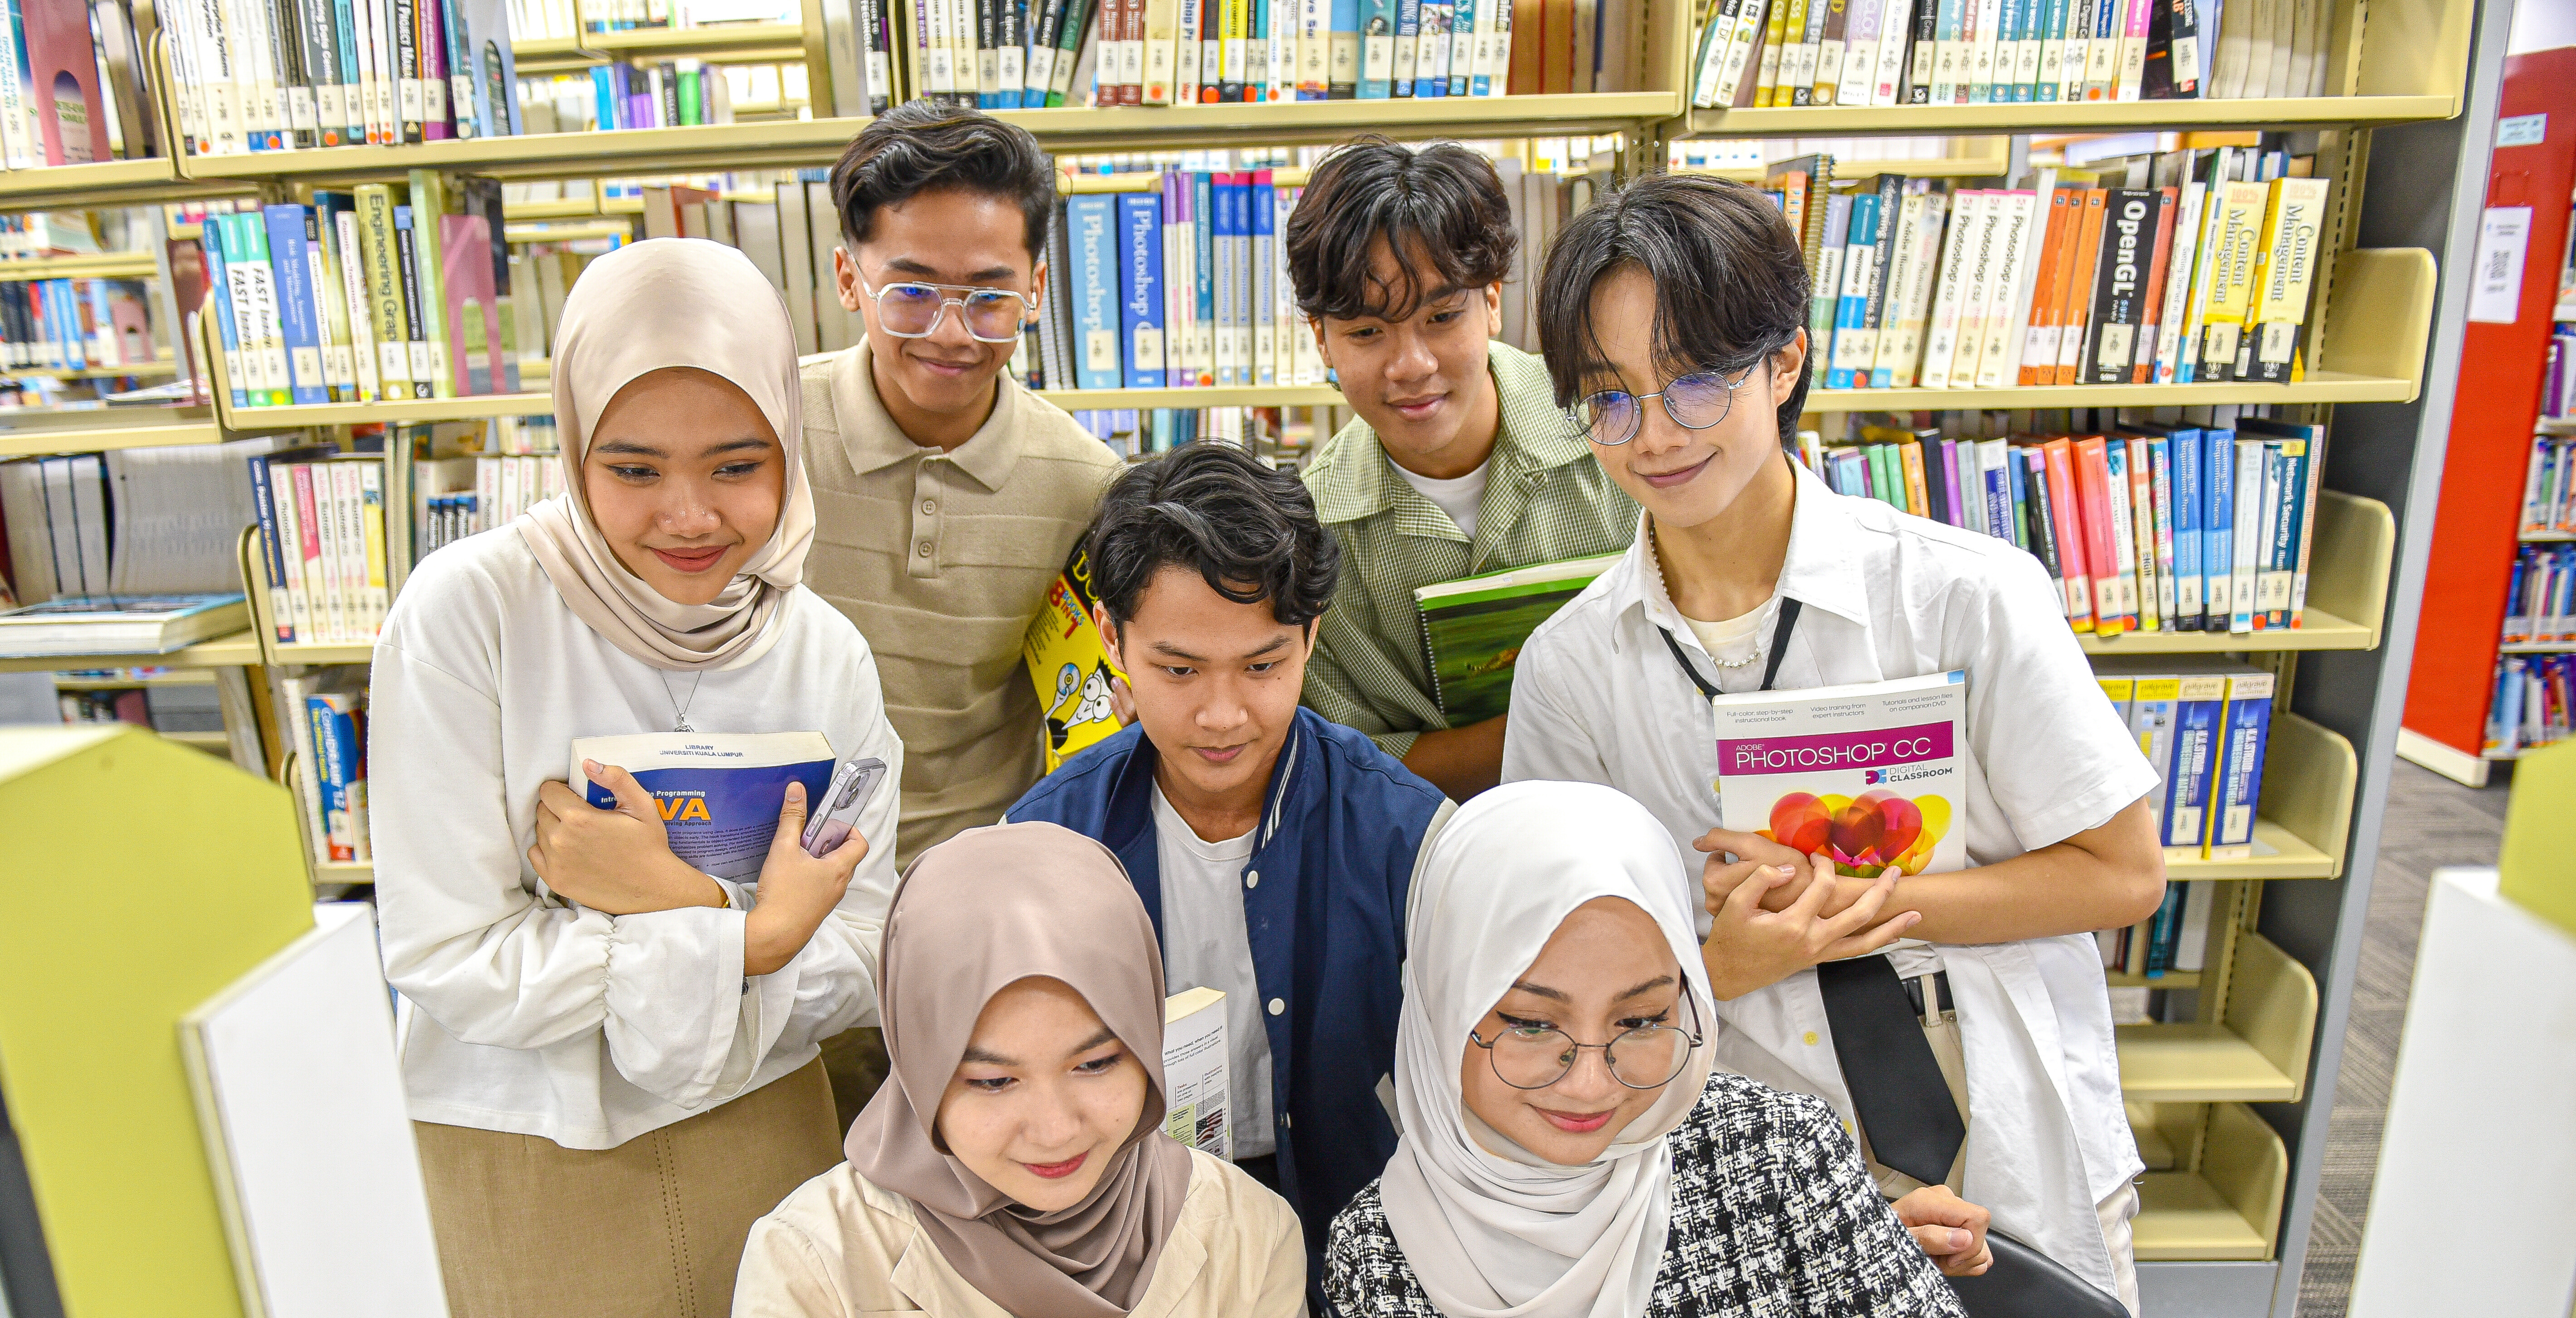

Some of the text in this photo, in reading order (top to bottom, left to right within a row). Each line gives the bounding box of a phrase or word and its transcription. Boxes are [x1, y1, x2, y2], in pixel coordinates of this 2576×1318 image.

[1129, 210, 1155, 316] Photoshop
[1873, 240, 1886, 265] web
[1947, 215, 1970, 282] Photoshop
[1974, 215, 1997, 282] Photoshop
[2000, 215, 2024, 282] Photoshop
[2112, 200, 2147, 296] OpenGL
[2214, 209, 2246, 303] Management
[2232, 226, 2258, 286] Content
[2270, 204, 2303, 301] Management
[2289, 222, 2315, 283] Content
[232, 269, 249, 305] FAST
[253, 267, 269, 304] FAST
[369, 195, 400, 342] Engineering Grap
[1083, 214, 1107, 331] Photoshop
[2277, 457, 2298, 548] Network Security
[1049, 580, 1065, 607] 8
[1063, 590, 1085, 627] BOOKS
[2141, 680, 2176, 694] palgrave
[2184, 680, 2219, 693] palgrave
[2235, 679, 2269, 692] palgrave
[1756, 708, 1793, 716] step-by-step
[1898, 703, 1932, 711] companion
[1736, 737, 1931, 769] PHOTOSHOP CC
[1889, 764, 1927, 774] DIGITAL
[1889, 767, 1952, 783] CLASSROOM
[654, 798, 712, 821] VA
[1164, 1055, 1179, 1063] provides
